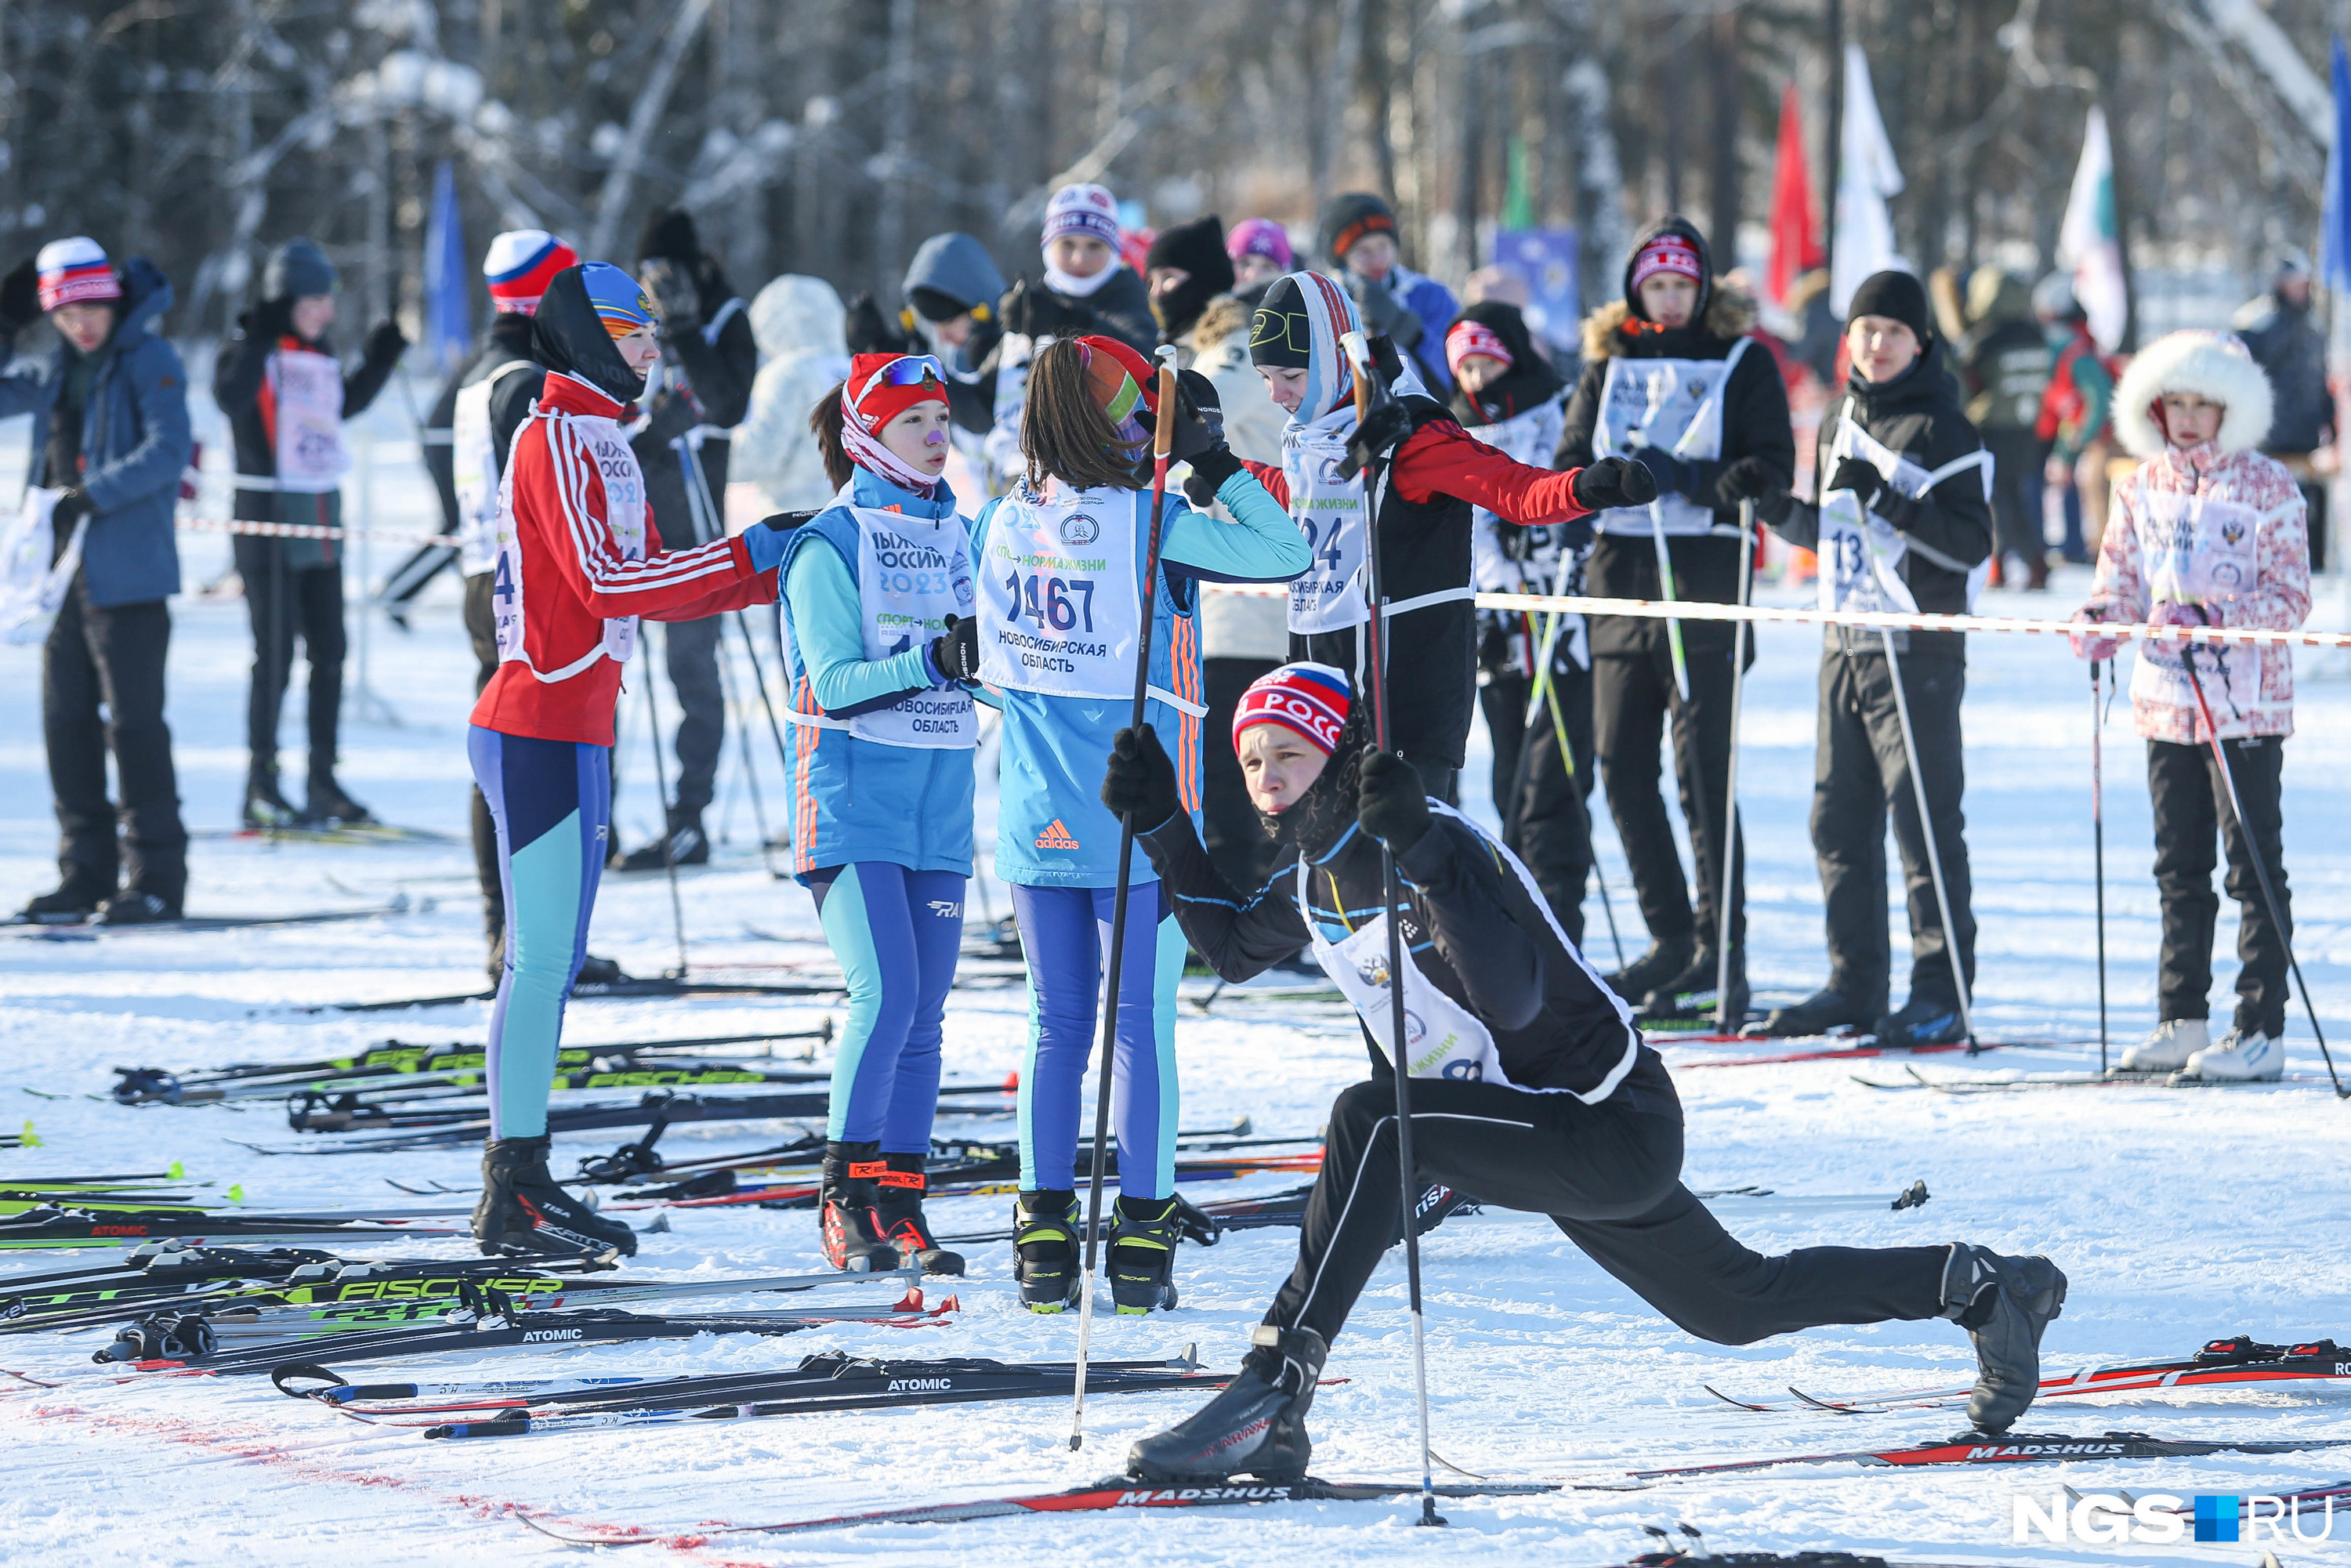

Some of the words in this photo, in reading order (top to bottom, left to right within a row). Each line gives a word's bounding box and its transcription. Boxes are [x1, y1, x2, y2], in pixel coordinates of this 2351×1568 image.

[1317, 497, 1358, 509] ЖИЗНИ
[1023, 555, 1063, 570] НОРМА
[1065, 558, 1107, 571] ЖИЗНИ
[880, 572, 947, 595] 2023
[1005, 570, 1095, 633] 1467
[877, 613, 914, 628] СПОРТ
[998, 630, 1107, 657] НОВОСИБИРСКАЯ
[1021, 653, 1074, 673] ОБЛАСТЬ
[912, 719, 959, 733] ОБЛАСТЬ
[1265, 693, 1341, 744] РОСС
[1034, 837, 1080, 850] adidas
[542, 1201, 572, 1219] TISA
[90, 1225, 150, 1237] ATOMIC
[522, 1328, 583, 1343] ATOMIC
[887, 1378, 952, 1392] ATOMIC
[1965, 1443, 2125, 1459] MADSHUS
[1117, 1487, 1291, 1506] MADSHUS
